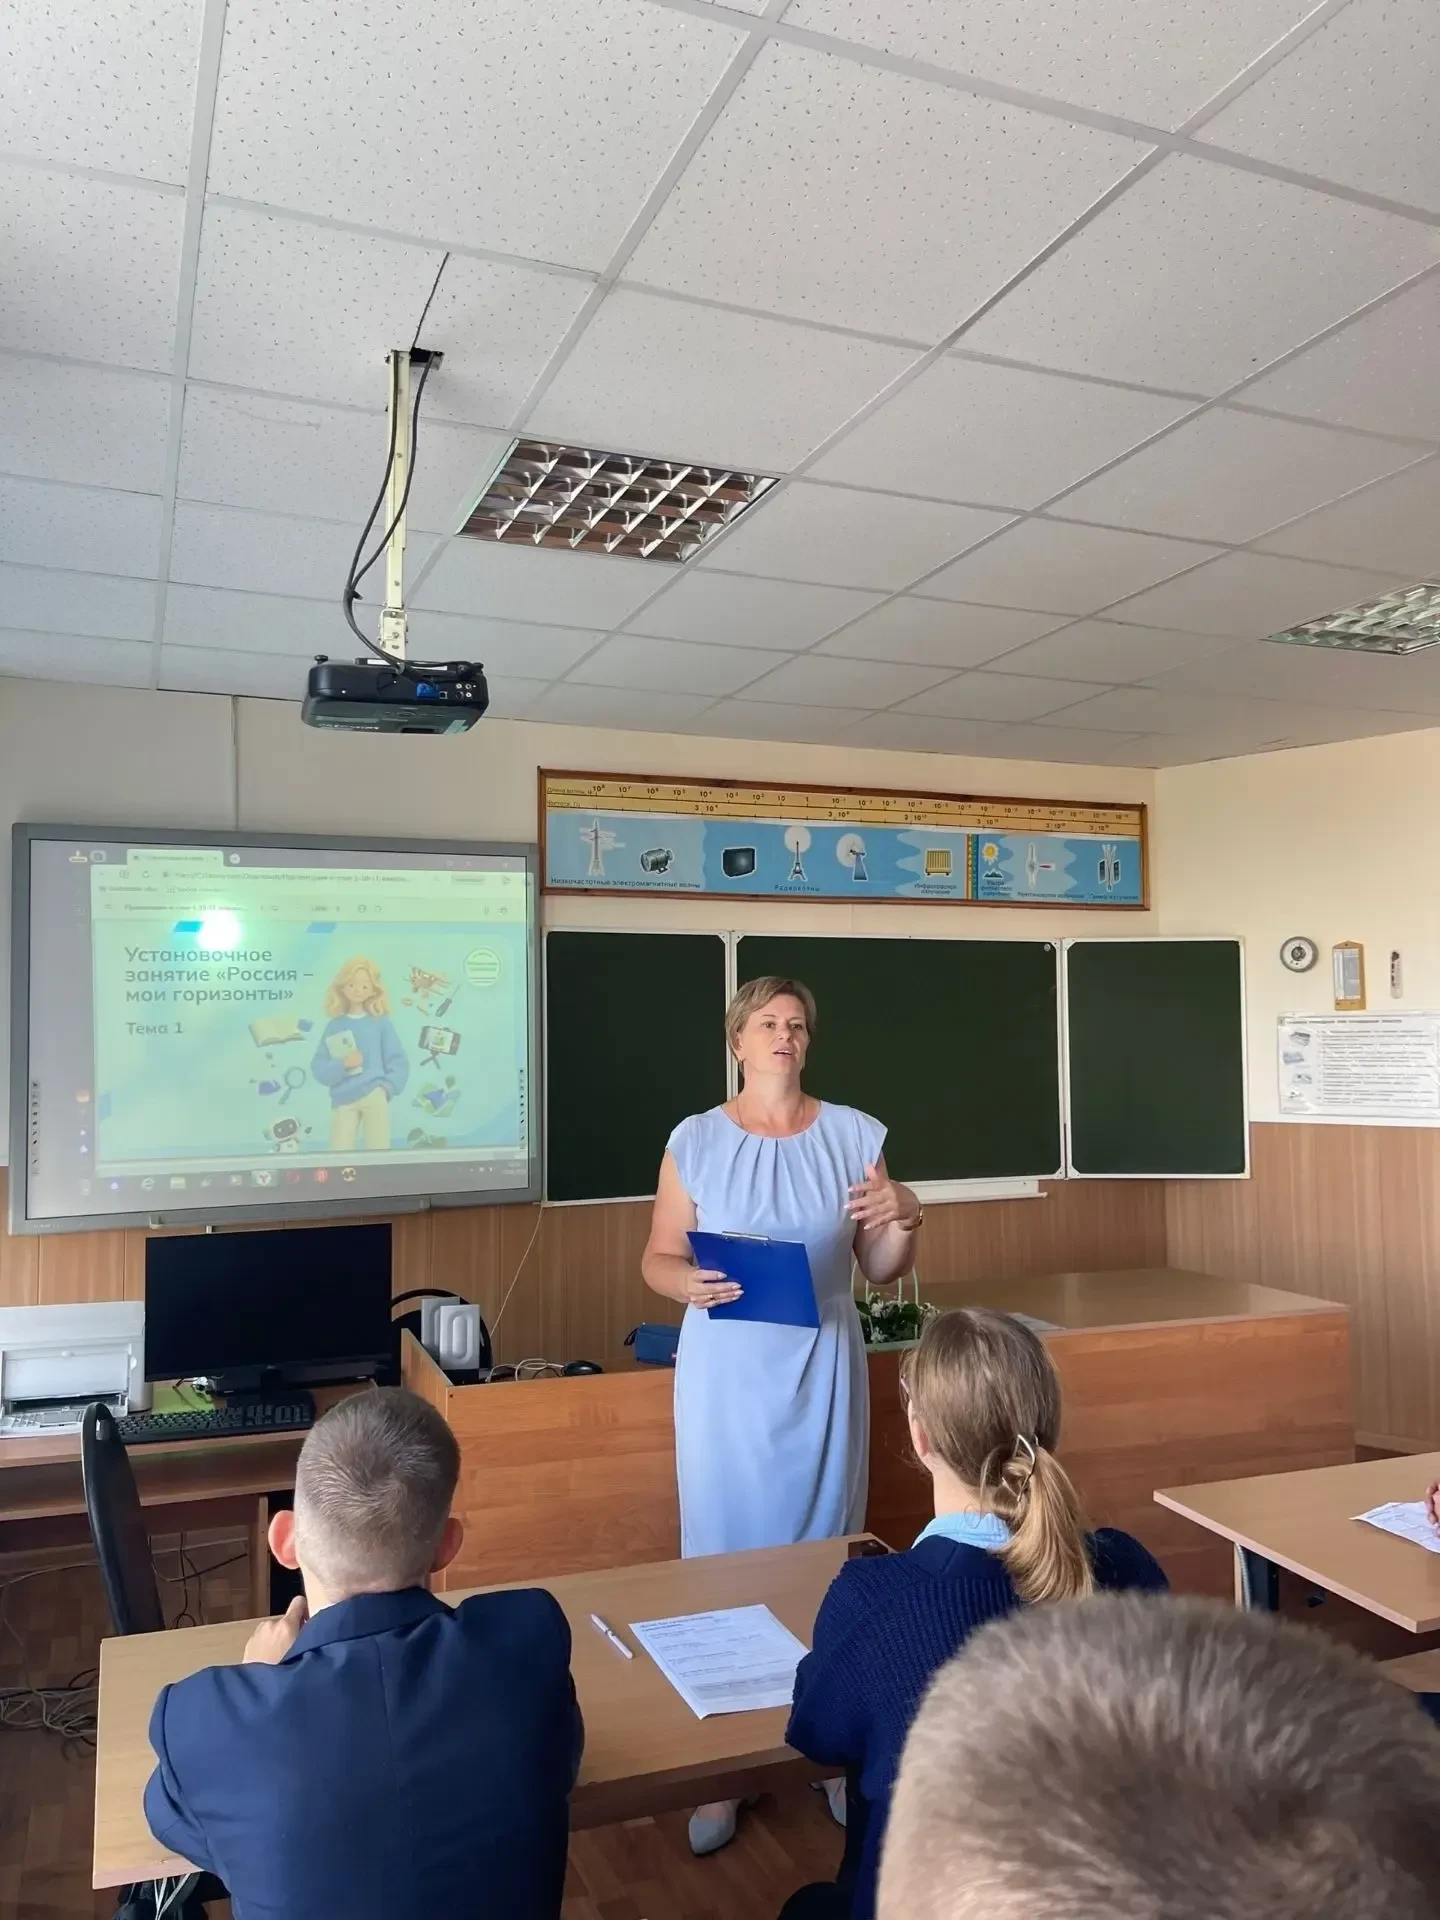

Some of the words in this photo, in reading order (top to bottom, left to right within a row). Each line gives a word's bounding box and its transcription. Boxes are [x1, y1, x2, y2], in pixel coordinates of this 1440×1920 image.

[124, 946, 273, 963] Установочное
[124, 969, 210, 983] занятие
[216, 966, 298, 982] «Россия
[126, 990, 167, 1002] мои
[173, 988, 294, 1006] горизонты»
[126, 1022, 169, 1035] Тема
[175, 1022, 184, 1034] 1
